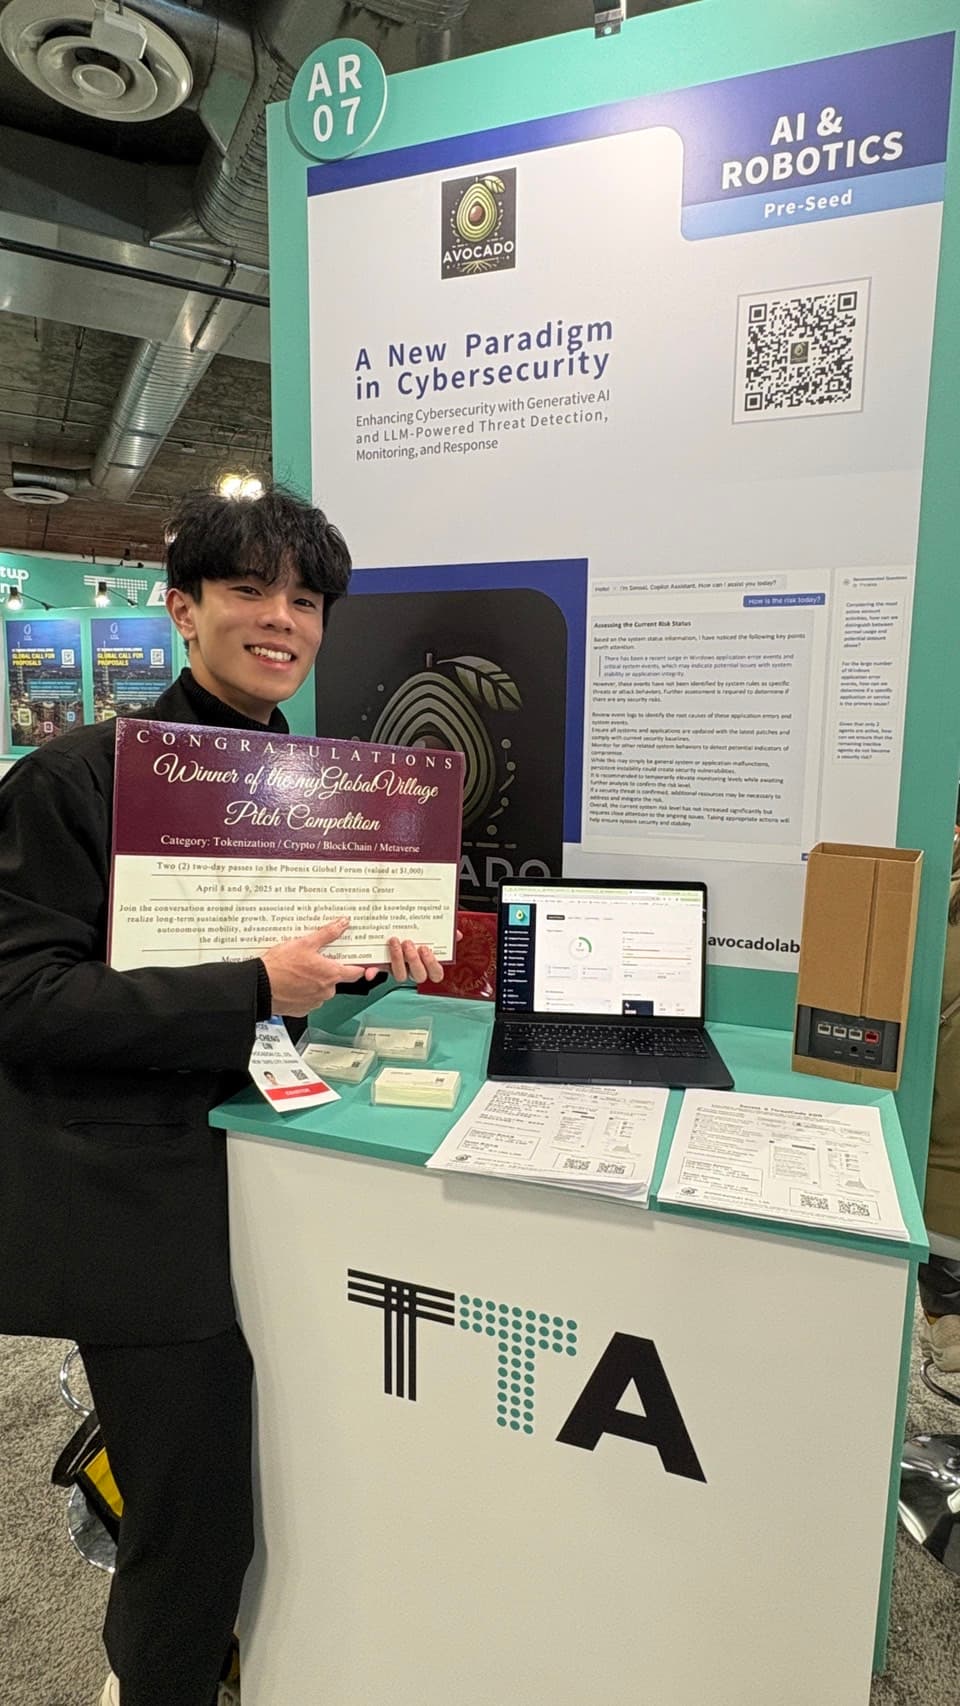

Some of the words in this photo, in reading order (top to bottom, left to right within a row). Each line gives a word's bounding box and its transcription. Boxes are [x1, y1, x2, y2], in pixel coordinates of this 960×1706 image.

[307, 54, 362, 102] AR
[312, 97, 361, 143] 07
[770, 112, 805, 145] AI
[816, 106, 843, 137] &
[721, 131, 903, 190] ROBOTICS
[764, 189, 853, 219] Pre-Seed
[442, 240, 514, 265] AVOCADO
[355, 348, 371, 372] A
[388, 342, 447, 368] New
[465, 319, 613, 358] Paradigm
[355, 376, 380, 400] in
[397, 350, 610, 399] Cybersecurity
[356, 412, 414, 429] Enhancing
[415, 402, 496, 423] Cybersecurity
[497, 398, 525, 412] with
[526, 392, 596, 409] Generative
[596, 389, 610, 402] AI
[356, 431, 380, 444] and
[384, 422, 474, 441] LLM-Powered
[479, 417, 526, 432] Threat
[530, 409, 608, 427] Detection,
[356, 445, 418, 462] Monitoring,
[420, 442, 441, 456] and
[443, 438, 498, 453] Response
[136, 730, 453, 769] CONGRATULATIONS
[153, 753, 239, 783] Winner
[244, 766, 265, 795] of
[267, 766, 292, 790] the
[224, 800, 281, 826] Pitch
[286, 804, 381, 836] Competition
[160, 835, 210, 848] Category:
[212, 837, 276, 848] Tokenization
[277, 839, 282, 848] /
[283, 839, 316, 851] Crypto
[316, 840, 322, 849] /
[323, 841, 372, 851] BlockChain
[374, 843, 378, 851] /
[379, 843, 420, 852] Metaverse
[156, 862, 176, 870] Two
[178, 862, 190, 871] (2)
[265, 864, 278, 872] the
[311, 865, 337, 873] Global
[399, 867, 424, 875] $1,000)
[195, 885, 218, 893] April
[119, 904, 137, 912] Join
[139, 904, 152, 912] the
[199, 936, 212, 944] the
[213, 936, 238, 944] digital
[347, 1268, 707, 1484] TTA
